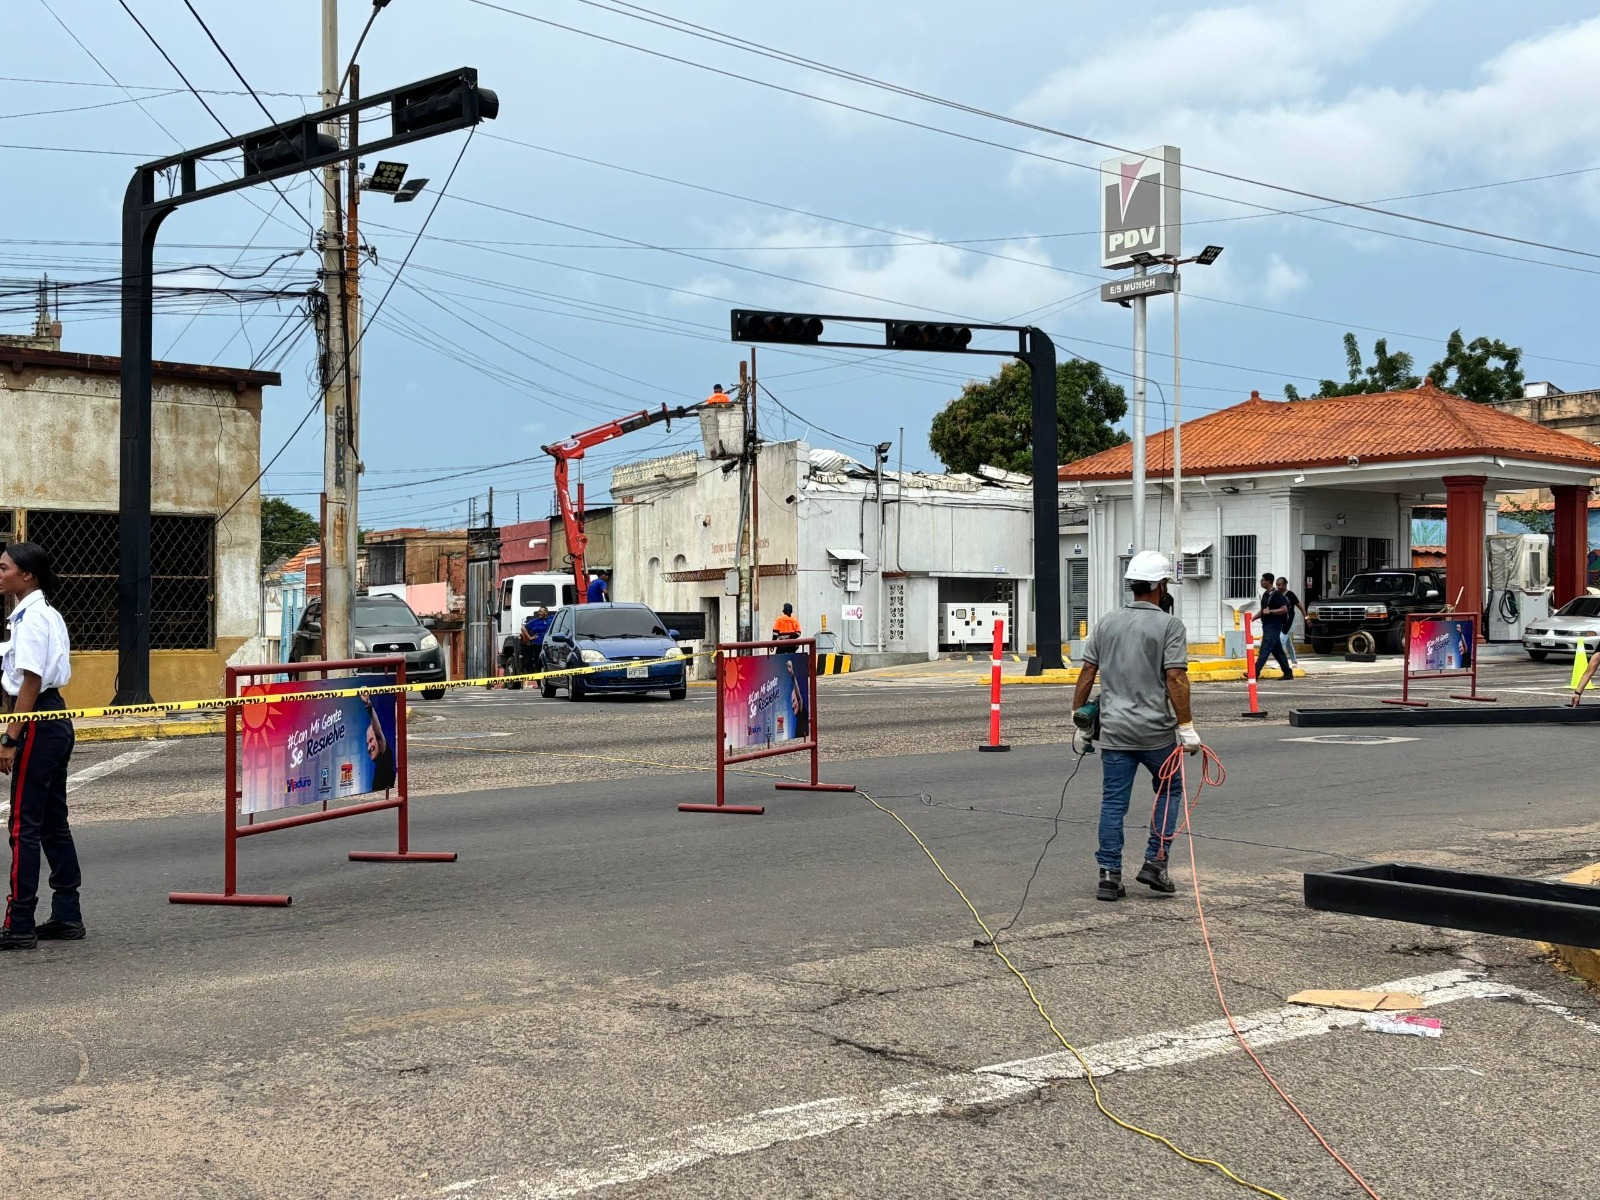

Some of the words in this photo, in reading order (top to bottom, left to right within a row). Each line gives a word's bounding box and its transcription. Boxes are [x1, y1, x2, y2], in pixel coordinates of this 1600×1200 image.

[1109, 225, 1156, 252] PDV
[1109, 285, 1122, 295] E/S
[1123, 278, 1156, 292] MUNICH
[287, 730, 308, 750] #Con
[310, 718, 320, 736] Mi
[321, 709, 342, 730] Gente
[290, 747, 303, 768] Se
[306, 723, 345, 759] Resuelve
